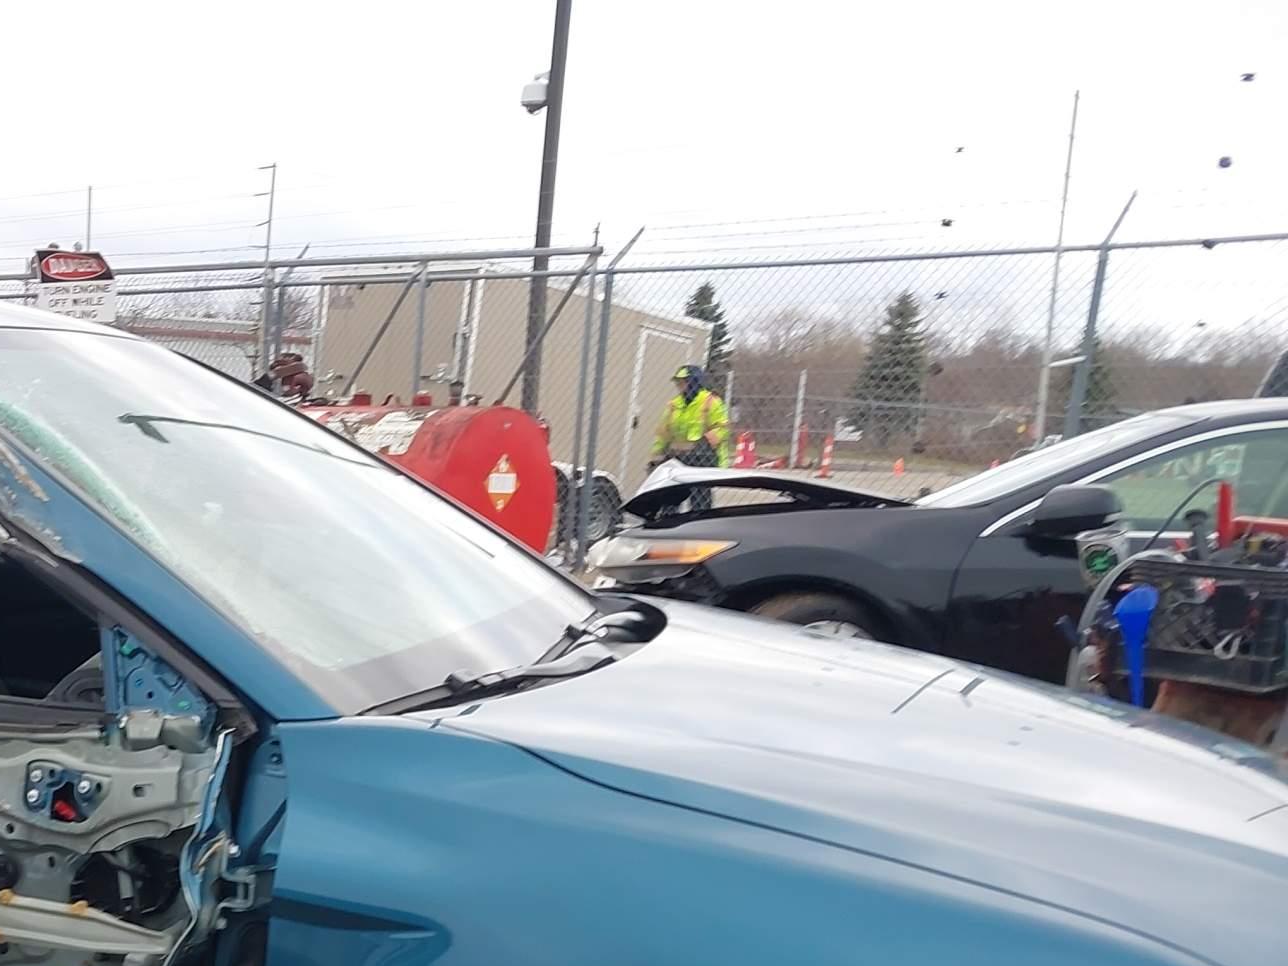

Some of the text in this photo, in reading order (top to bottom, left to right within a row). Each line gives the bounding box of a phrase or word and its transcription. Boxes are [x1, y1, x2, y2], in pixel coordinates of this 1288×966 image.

[48, 257, 102, 274] DANGER
[43, 283, 112, 296] TURN ENGINE
[49, 296, 105, 308] OFF WHILE
